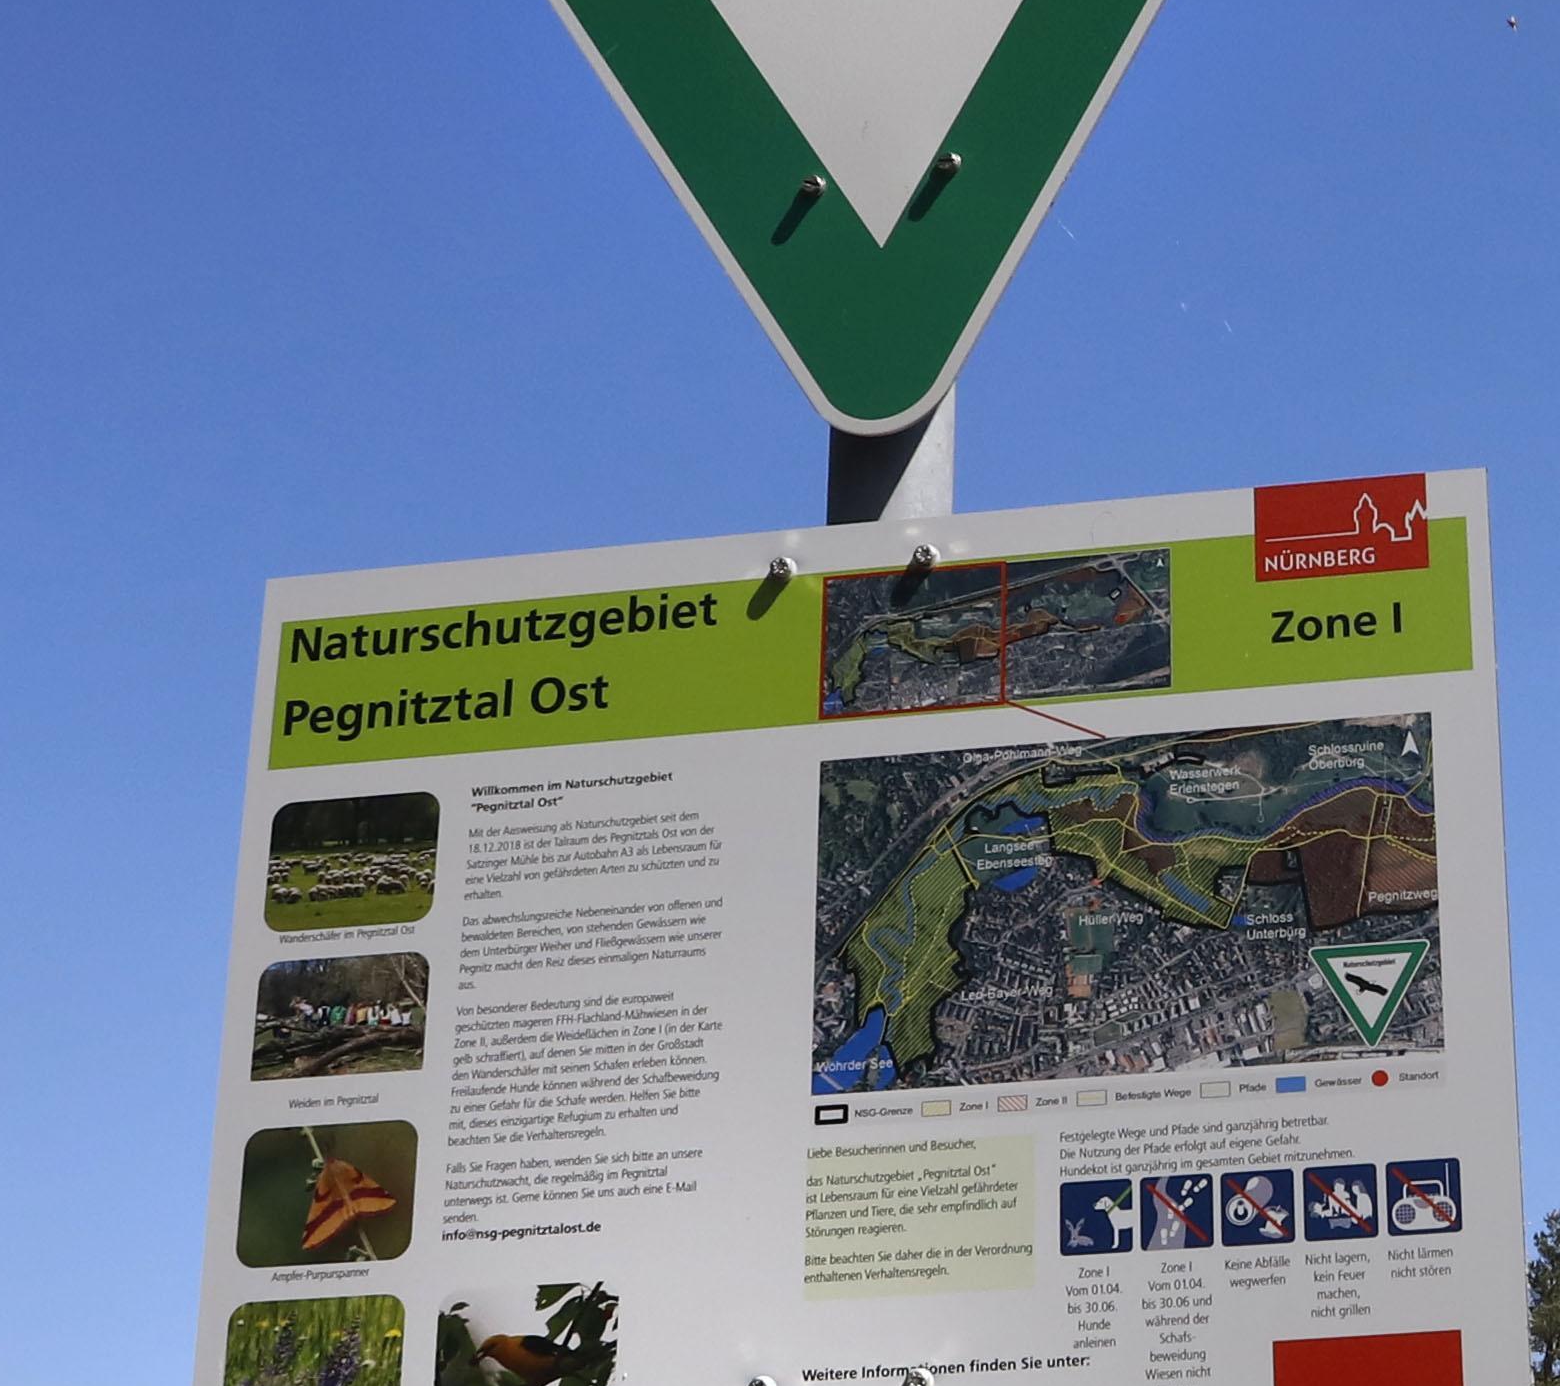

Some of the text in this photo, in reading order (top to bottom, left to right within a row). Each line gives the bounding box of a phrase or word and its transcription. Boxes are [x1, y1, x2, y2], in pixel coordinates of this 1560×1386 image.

[1265, 547, 1375, 572] NÜRNBERG
[292, 593, 717, 663] Naturschutzgebiet
[1272, 611, 1376, 643] Zone
[284, 676, 608, 740] Pegnitztal Ost
[1170, 767, 1241, 780] Wasserwerk
[472, 772, 672, 797] Willkommen im Naturschutzgebiet
[984, 841, 1034, 855] Langsee
[1368, 887, 1438, 903] Pegnitzweg
[1246, 913, 1293, 926] Schloss
[279, 925, 415, 944] Wanderschäfer im Pegnitztal Ost
[289, 1098, 321, 1109] Weiden
[337, 1093, 379, 1107] Pegnitztal
[1060, 1130, 1115, 1144] Festgelegte
[1118, 1128, 1146, 1141] Wege
[1149, 1125, 1168, 1137] und
[1172, 1123, 1199, 1135] Pfade
[1203, 1121, 1223, 1133] sind
[1226, 1119, 1278, 1134] ganzjährig
[807, 1139, 976, 1159] Liebe Besucherinnen und Besucher,
[1060, 1149, 1076, 1160] Die
[1079, 1148, 1121, 1159] Nutzung
[1124, 1144, 1140, 1155] der
[1144, 1142, 1171, 1154] Pfade
[1174, 1140, 1206, 1154] erfolgt
[1210, 1138, 1226, 1149] auf
[1229, 1138, 1262, 1151] eigene
[1060, 1164, 1107, 1176] Hundekot
[1111, 1163, 1122, 1173] ist
[1125, 1159, 1177, 1175] ganzjährig
[1181, 1159, 1193, 1168] im
[1196, 1157, 1245, 1171] gesamten
[1248, 1152, 1281, 1165] Gebiet
[806, 1175, 823, 1187] das
[826, 1170, 914, 1185] Naturschutzgebiet
[806, 1181, 1018, 1204] ist Lebensraum für eine Vielzahl gefährdeter
[806, 1197, 1017, 1221] Pflanzen und Tiere, die sehr empfindlich auf
[806, 1223, 906, 1239] Störungen reagieren.
[805, 1243, 1033, 1266] Bitte beachten Sie daher die in der Verordnung
[1305, 1253, 1331, 1265] Nicht
[1388, 1247, 1453, 1260] Nicht lärmen
[1161, 1262, 1186, 1273] Zone
[1225, 1256, 1290, 1270] Keine Abfälle
[271, 1269, 369, 1283] Ampfer-Purpurspanner
[804, 1264, 949, 1283] enthaltenen Verhaltensregeln.
[1078, 1267, 1103, 1279] Zone
[1314, 1270, 1365, 1282] kein Feuer
[1391, 1265, 1451, 1278] nicht stören
[1148, 1281, 1171, 1291] Vom
[1230, 1273, 1286, 1290] wegwerfen
[1066, 1286, 1088, 1296] Vom
[1317, 1287, 1360, 1299] machen,
[1068, 1303, 1081, 1314] bis
[1142, 1294, 1212, 1309] bis 30.06 und
[1311, 1303, 1370, 1319] nicht grillen
[1078, 1319, 1111, 1331] Hunde
[1145, 1313, 1209, 1327] während der
[1073, 1337, 1116, 1349] anleinen
[1150, 1349, 1206, 1362] beweidung
[802, 1368, 857, 1381] Weitere
[970, 1359, 1016, 1372] finden
[1022, 1357, 1042, 1369] Sie
[1047, 1356, 1090, 1368] unter:
[1145, 1366, 1211, 1380] Wiesen nicht
